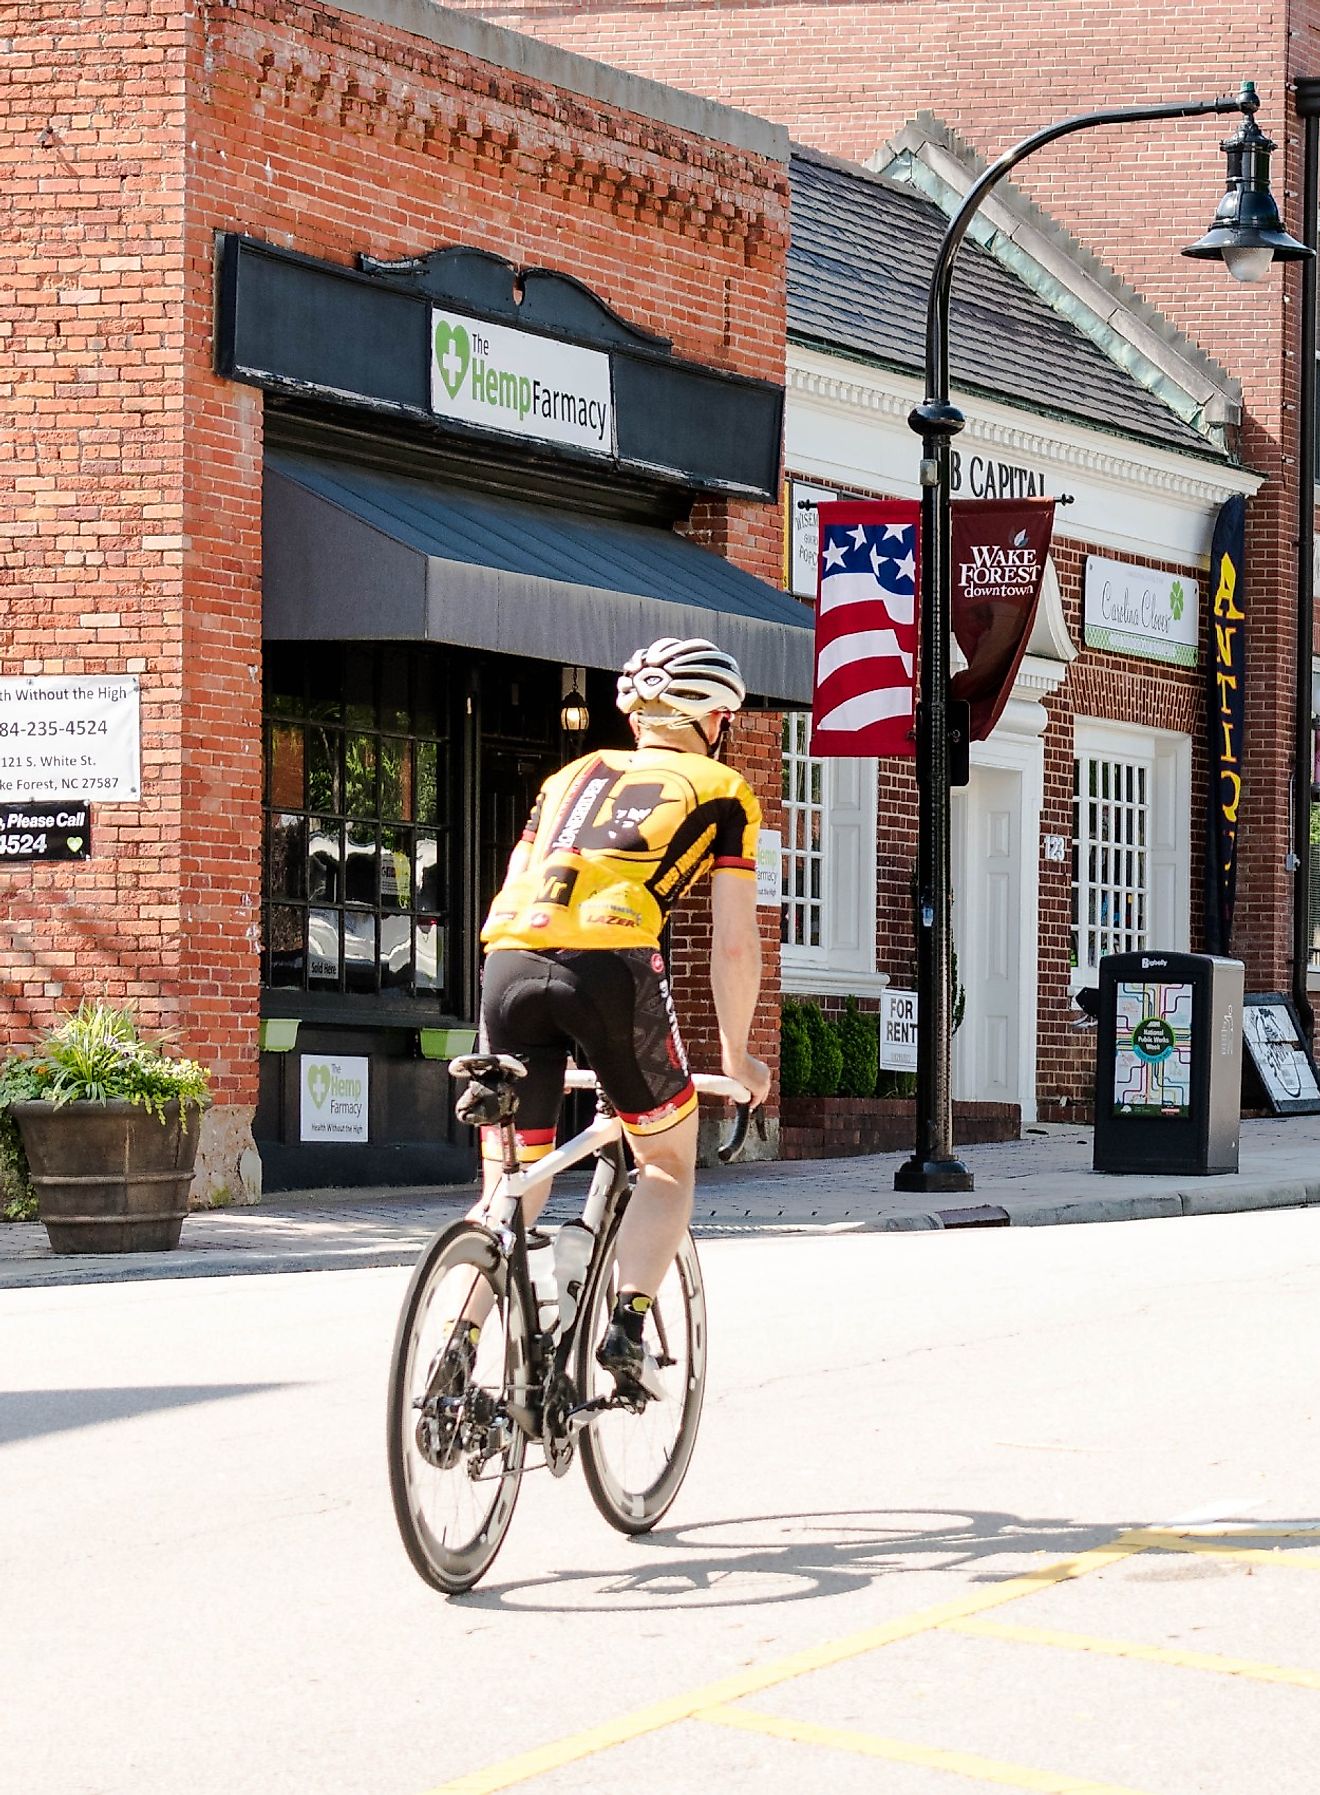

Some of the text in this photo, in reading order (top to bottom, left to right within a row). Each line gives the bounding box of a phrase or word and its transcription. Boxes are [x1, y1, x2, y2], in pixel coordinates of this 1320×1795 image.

[472, 333, 489, 355] The
[970, 545, 1037, 568] WAKE
[958, 563, 1042, 587] FOREST
[964, 581, 1034, 598] downtown
[1141, 589, 1173, 634] Clover
[15, 688, 69, 701] Without
[73, 687, 94, 699] the
[98, 686, 127, 702] High
[0, 720, 108, 737] 84-235-4524
[2, 755, 96, 768] 121 S. White St.
[17, 779, 58, 791] Forest,
[61, 778, 79, 789] NC
[82, 777, 119, 789] 27587
[7, 813, 55, 829] Please
[56, 811, 86, 827] Call
[1044, 835, 1065, 861] 123
[587, 915, 637, 928] LAZER
[311, 961, 337, 975] Sold Here
[890, 998, 913, 1020] FOR
[886, 1020, 919, 1043] RENT
[1137, 1035, 1170, 1044] Public Works
[1143, 1028, 1164, 1036] National
[331, 1063, 342, 1074] The
[331, 1075, 362, 1101] Hemp
[330, 1099, 363, 1118] Farmacy
